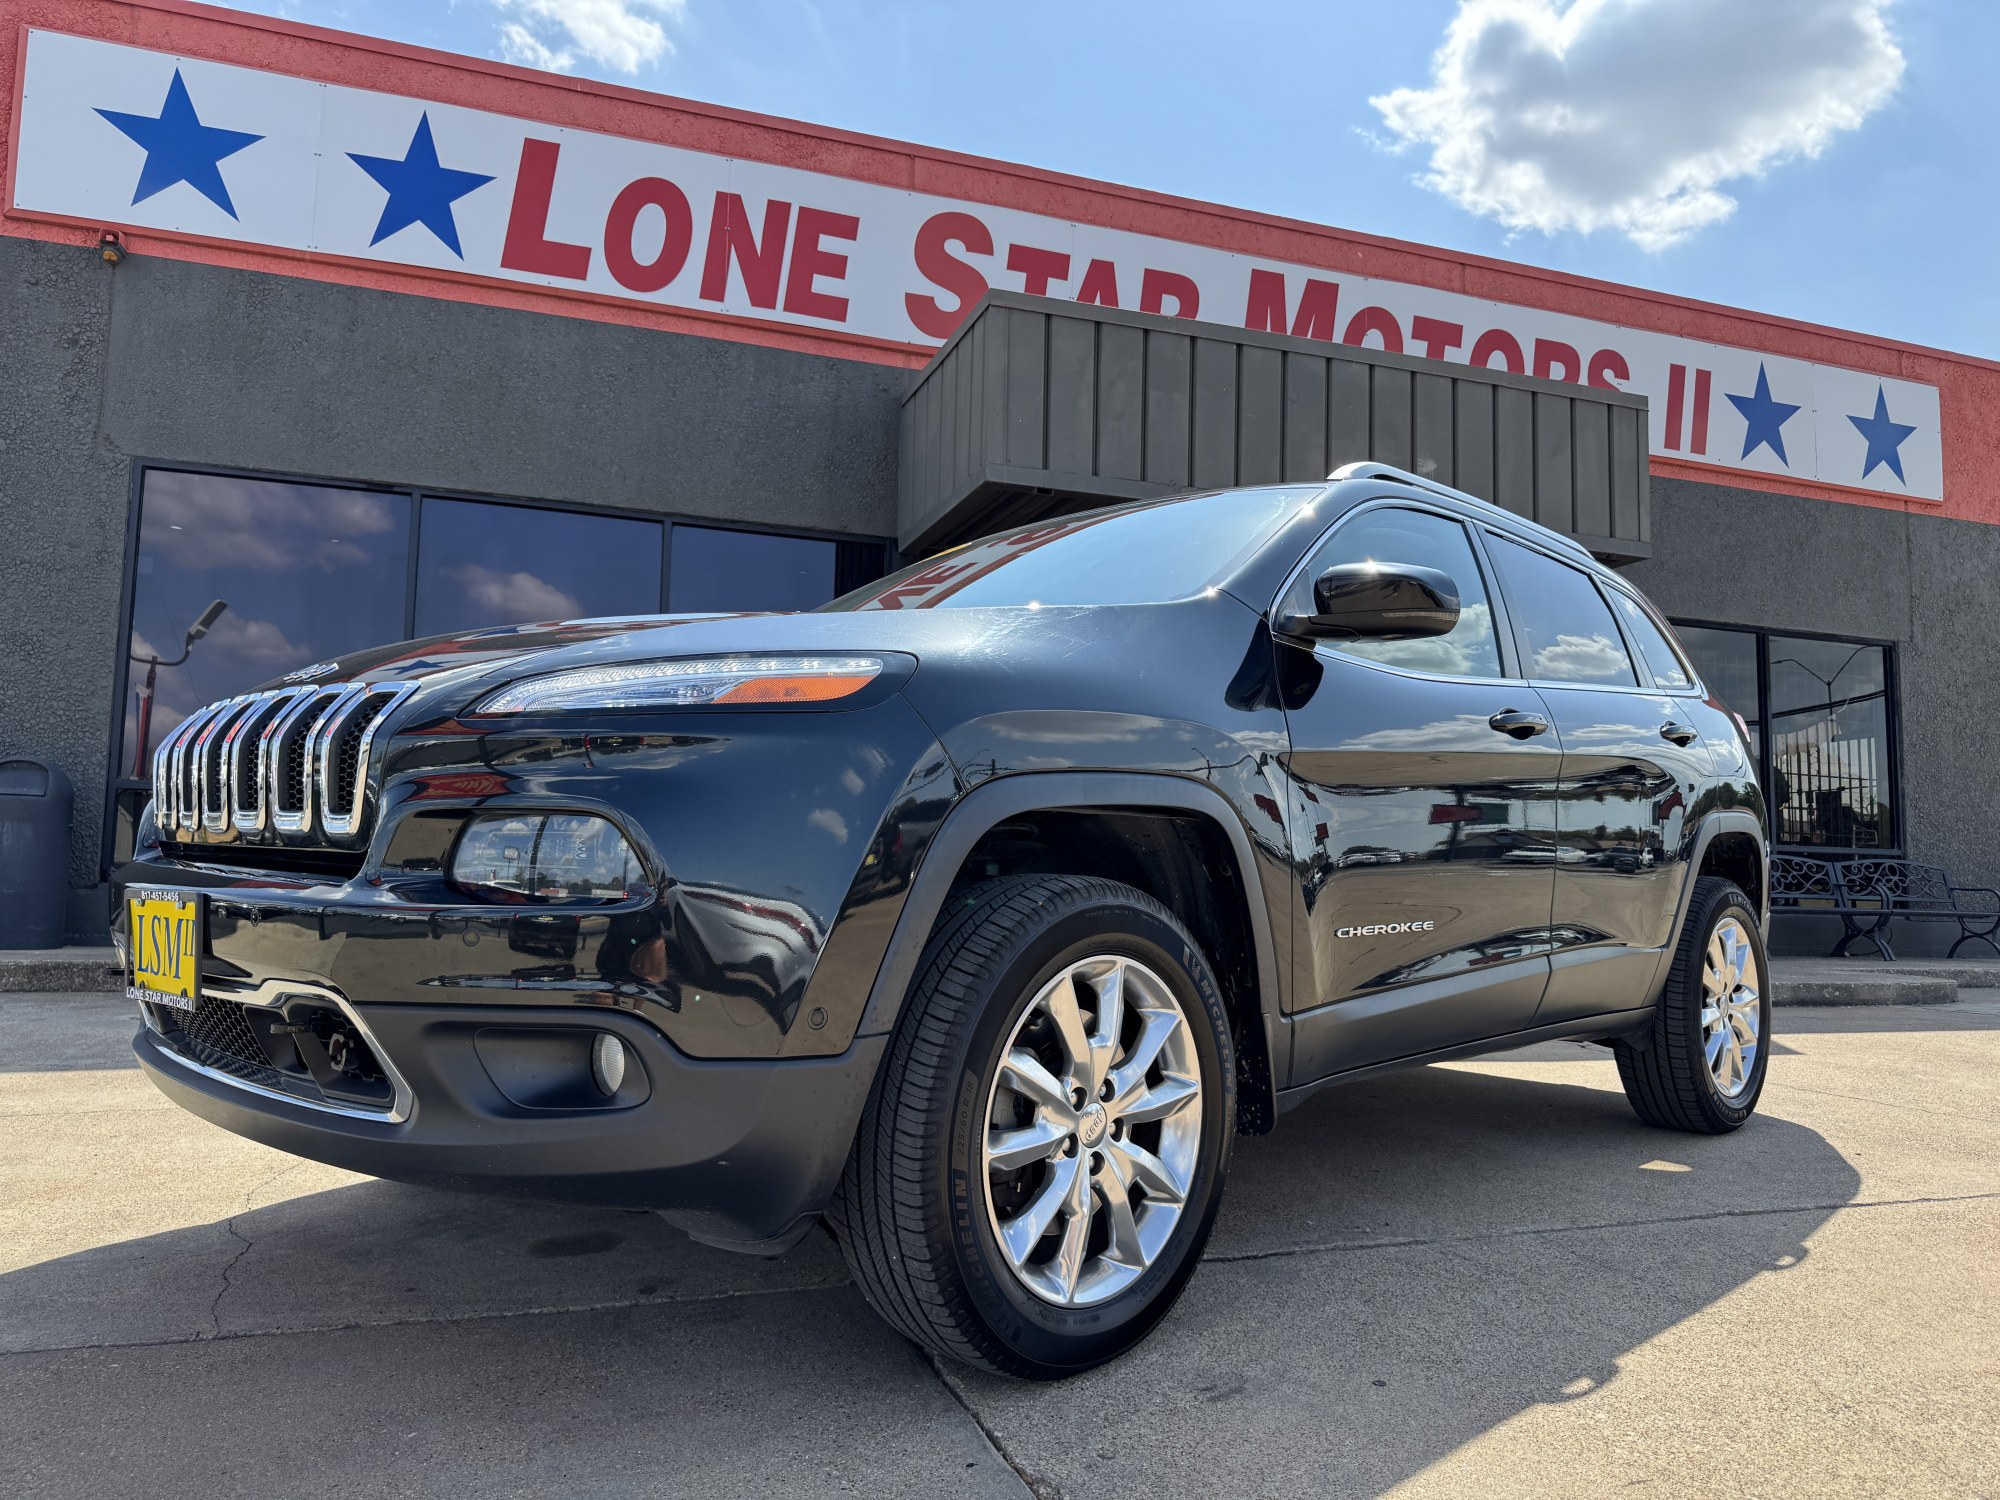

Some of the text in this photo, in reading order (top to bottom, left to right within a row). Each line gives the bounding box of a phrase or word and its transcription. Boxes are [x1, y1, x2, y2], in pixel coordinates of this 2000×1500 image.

[500, 137, 860, 323] LONE
[1664, 363, 1711, 455] II
[141, 890, 179, 901] 817-457-5456
[1336, 921, 1434, 938] CHEROKEE
[126, 986, 144, 1000] LONE
[145, 990, 161, 1003] STAR
[162, 993, 188, 1010] MOTORS
[1200, 979, 1233, 1088] MICHELIN
[957, 1111, 969, 1155] 225/60
[965, 1080, 974, 1093] 18
